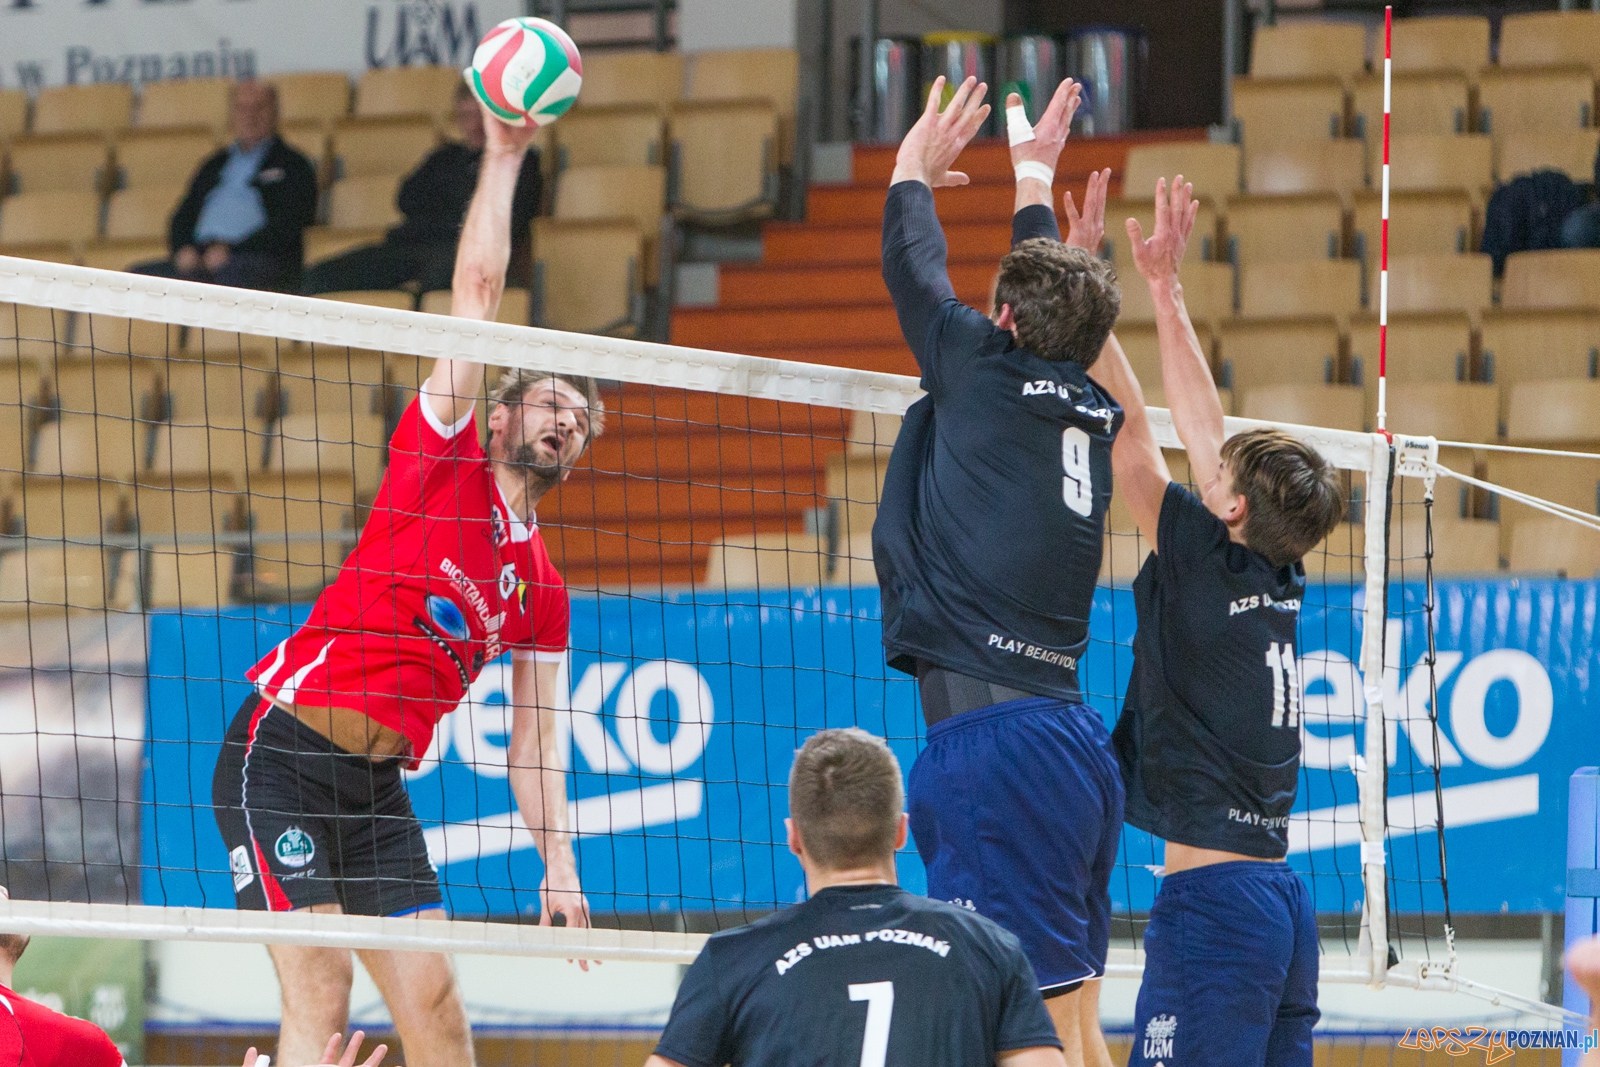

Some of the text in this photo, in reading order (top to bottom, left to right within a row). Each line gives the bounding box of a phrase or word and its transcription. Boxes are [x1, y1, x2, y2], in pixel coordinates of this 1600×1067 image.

[66, 37, 257, 84] Poznaniu
[1022, 380, 1056, 396] AZS
[1062, 426, 1093, 518] 9
[1229, 595, 1260, 616] AZS
[987, 633, 1025, 654] PLAY
[1265, 641, 1299, 728] 11
[1298, 617, 1554, 770] eko
[1228, 807, 1260, 826] PLAY
[775, 928, 951, 976] AZS UAM POZNAŃ
[847, 980, 895, 1067] 7
